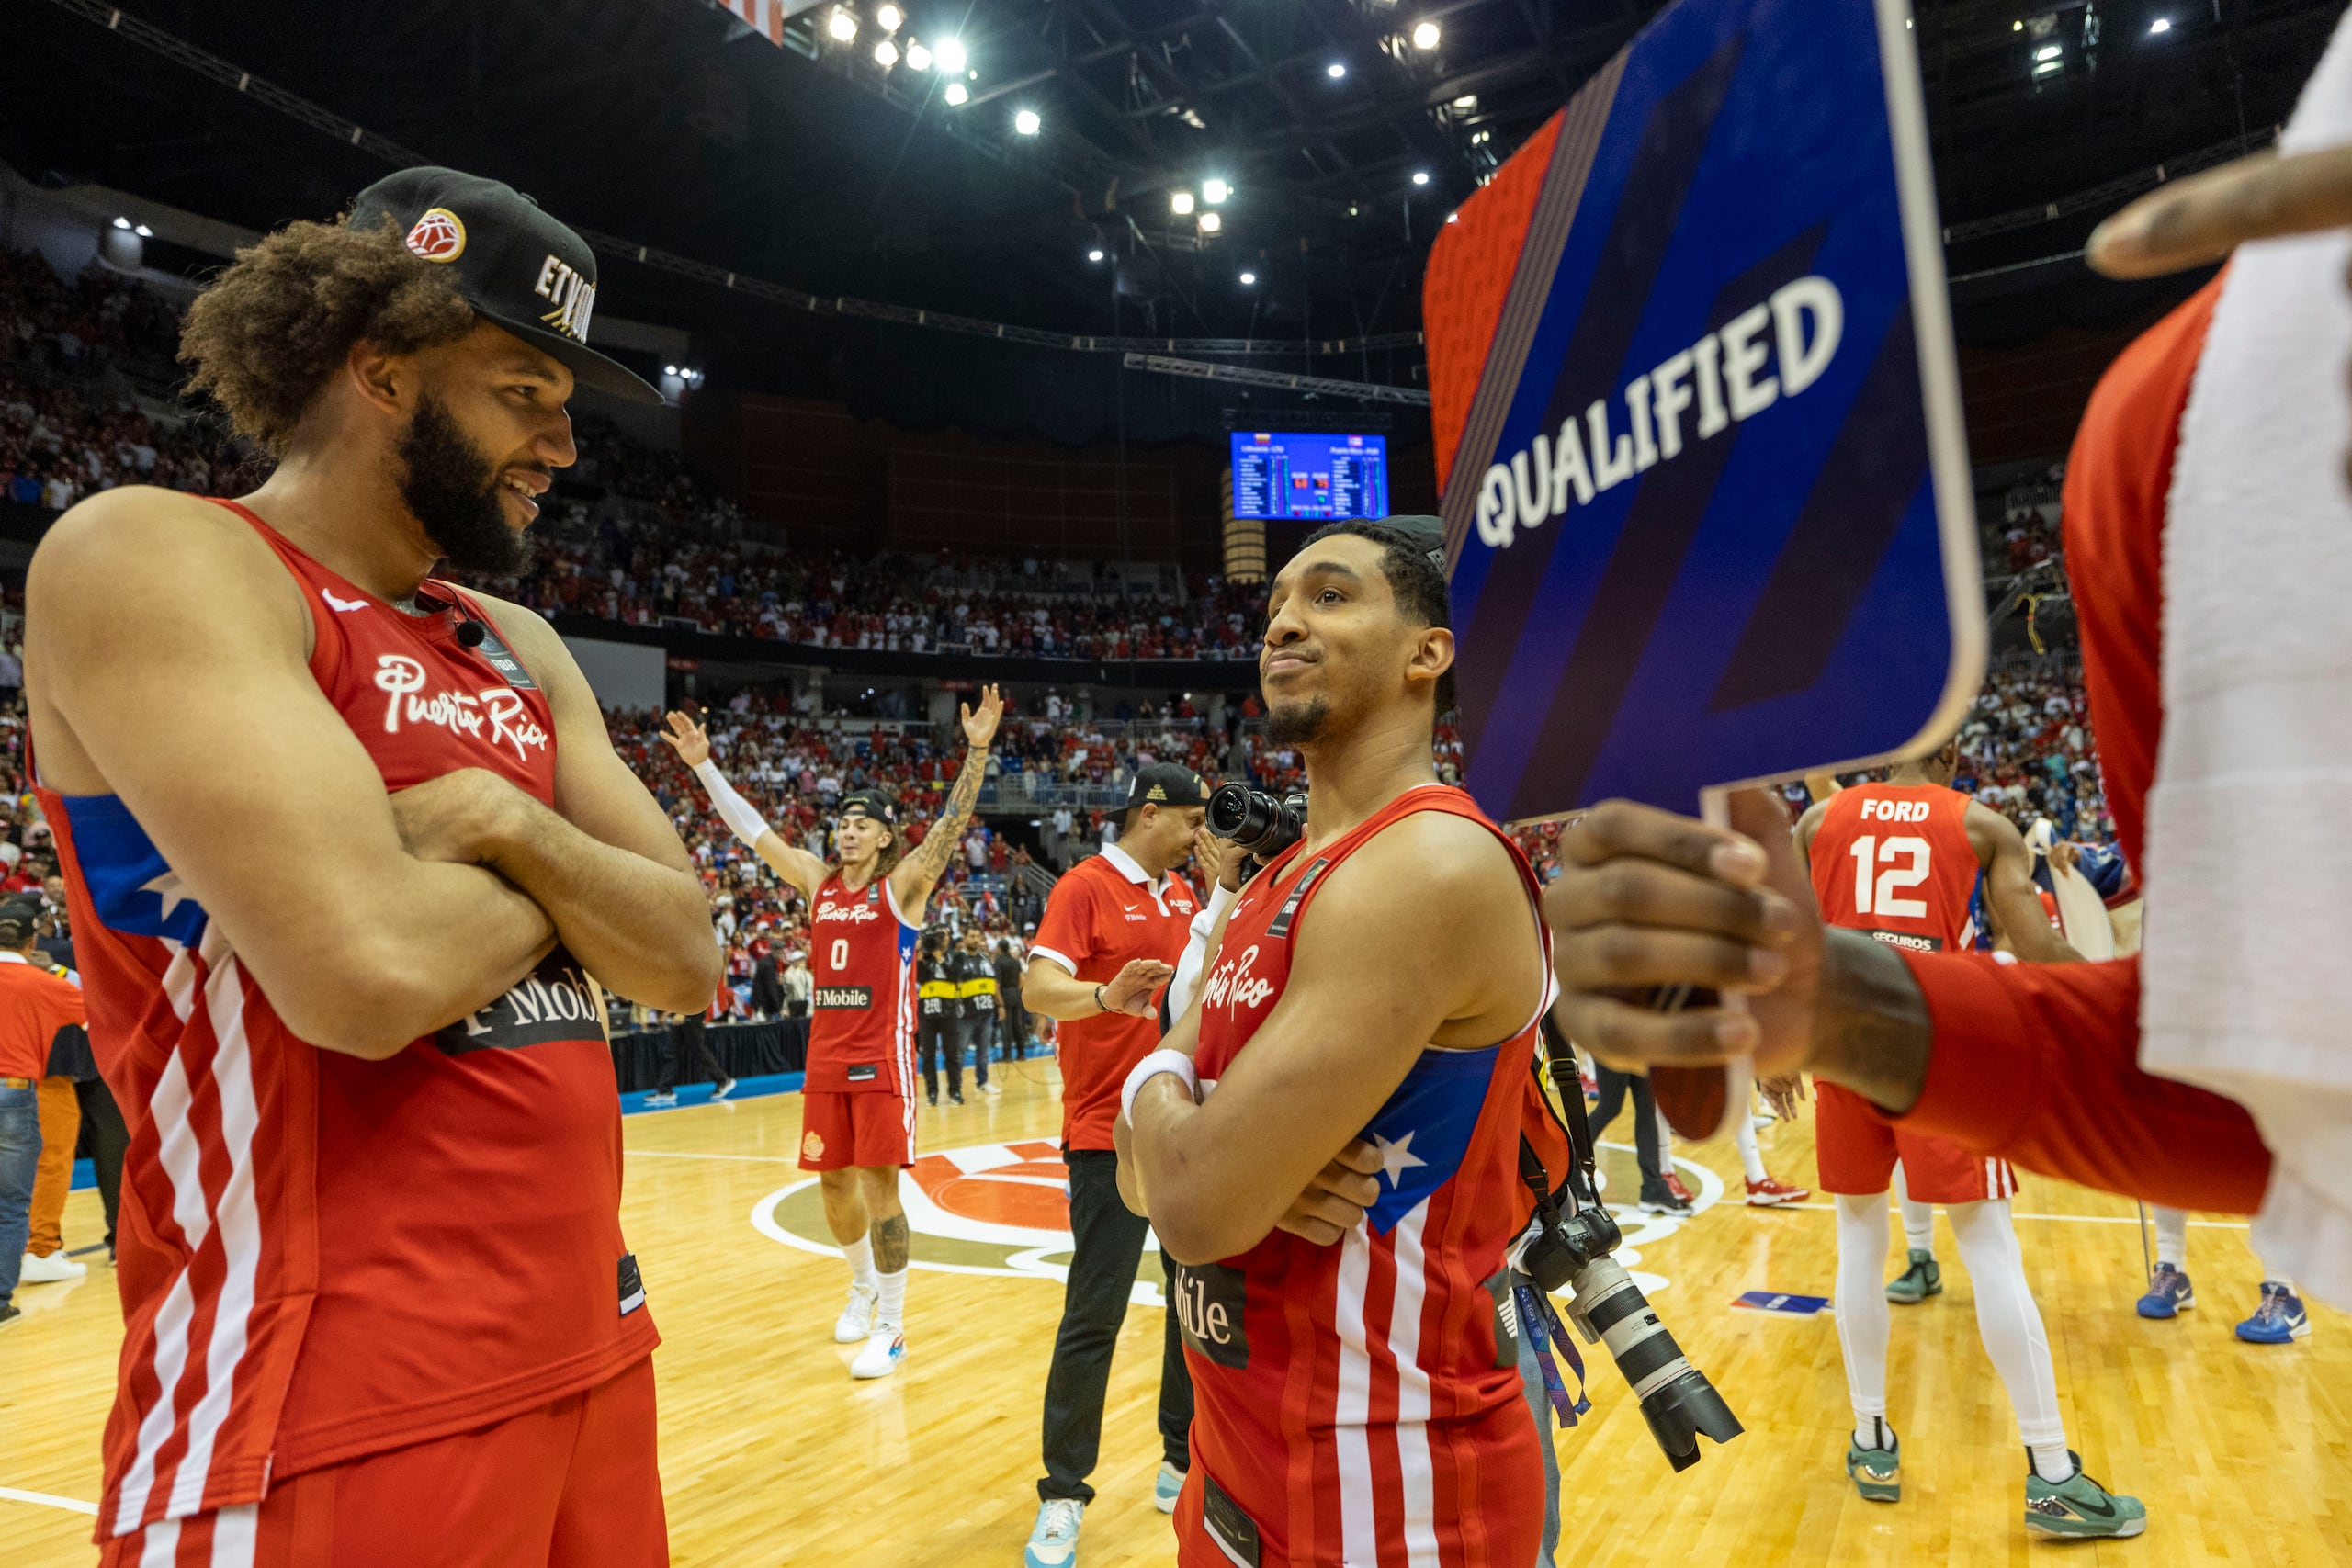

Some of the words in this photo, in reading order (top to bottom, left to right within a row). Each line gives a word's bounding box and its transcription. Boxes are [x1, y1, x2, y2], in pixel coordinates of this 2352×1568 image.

[1476, 276, 1845, 548] QUALIFIED
[375, 655, 483, 739] Puerto
[480, 688, 548, 761] Rico
[1860, 798, 1930, 822] FORD
[1849, 835, 1931, 919] 12
[815, 901, 850, 923] Puerto
[848, 904, 879, 925] Rico
[831, 939, 849, 971] 0
[1872, 931, 1932, 951] SEGUROS
[505, 967, 602, 1026] Mob
[822, 990, 868, 1006] Mobile
[1227, 944, 1274, 1022] Rico
